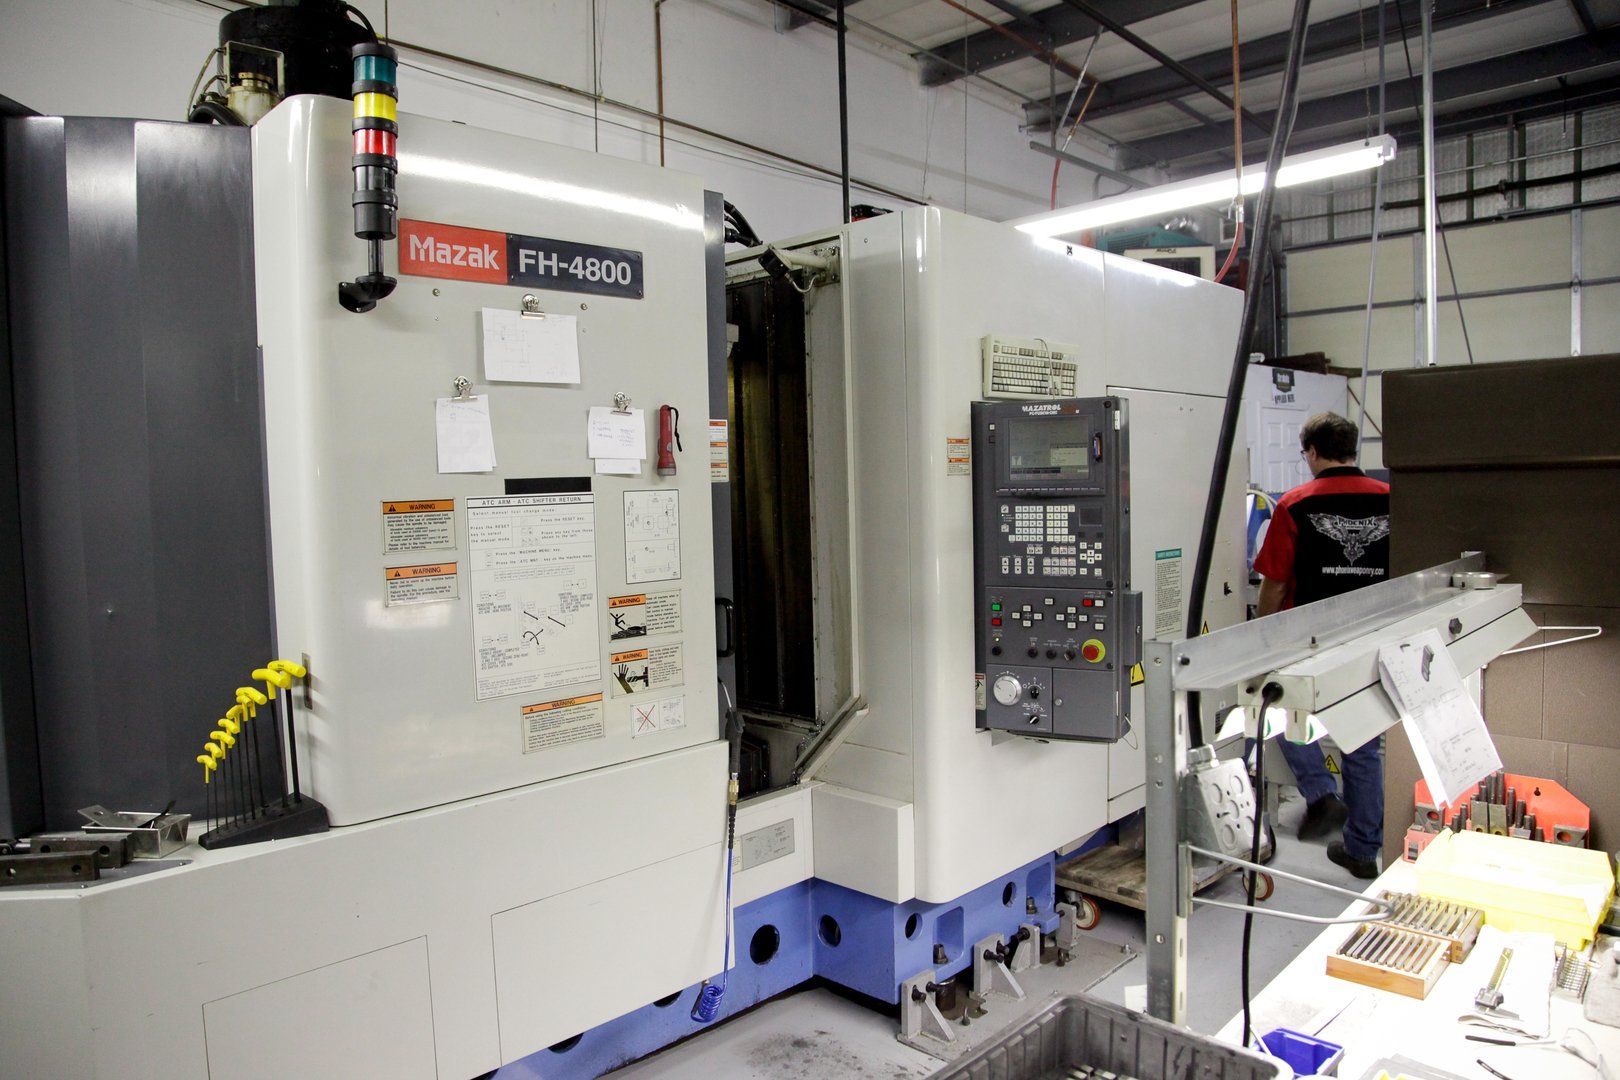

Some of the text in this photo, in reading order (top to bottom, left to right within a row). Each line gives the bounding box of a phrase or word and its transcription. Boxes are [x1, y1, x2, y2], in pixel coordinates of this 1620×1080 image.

[410, 234, 632, 285] Mazak FH-4800
[622, 652, 643, 660] WARNING
[552, 699, 576, 709] WARNING
